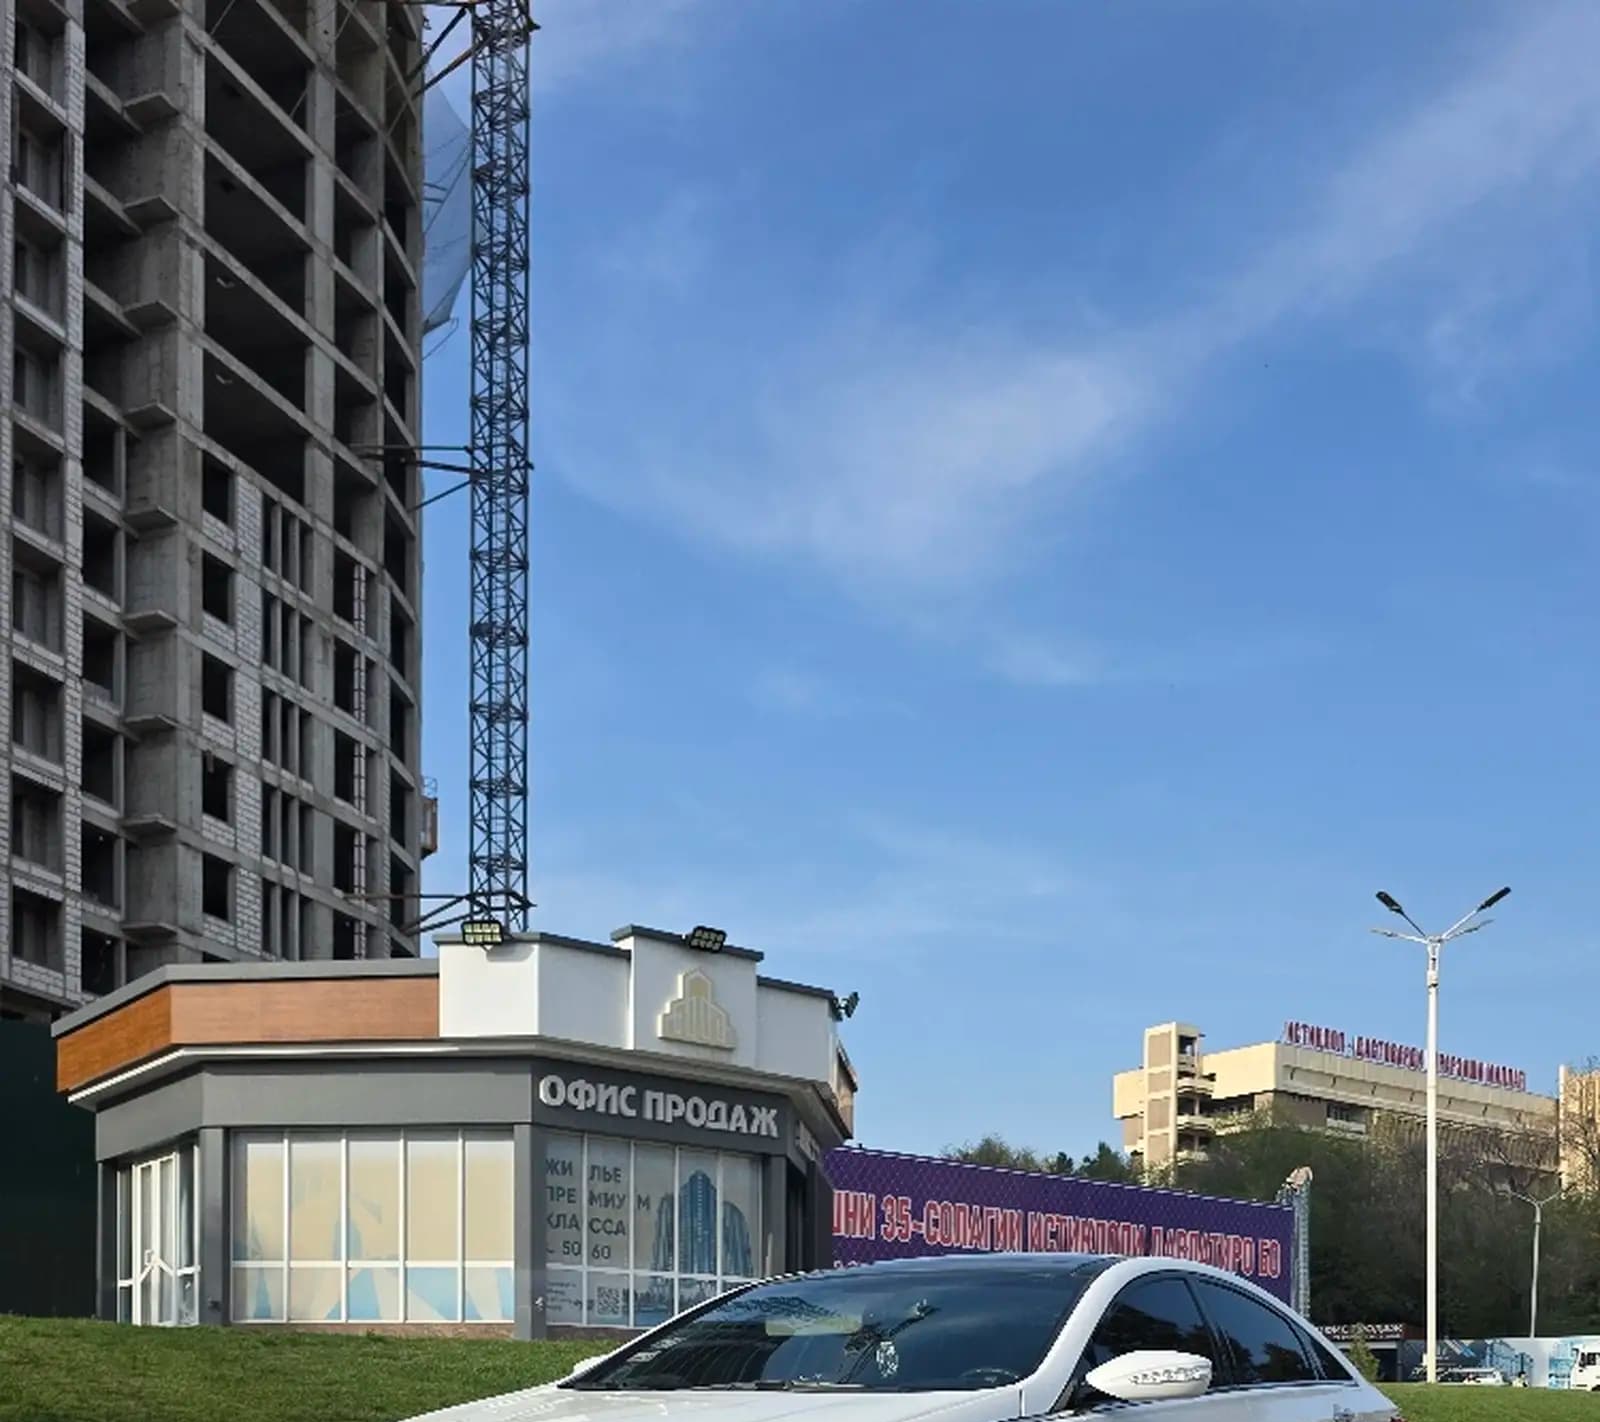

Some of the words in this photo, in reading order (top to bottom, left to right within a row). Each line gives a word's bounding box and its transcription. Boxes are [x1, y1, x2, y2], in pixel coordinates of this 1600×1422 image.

[539, 1074, 637, 1117] ОФИС
[643, 1089, 779, 1138] ПРОДАЖ
[1258, 1238, 1281, 1279] БО
